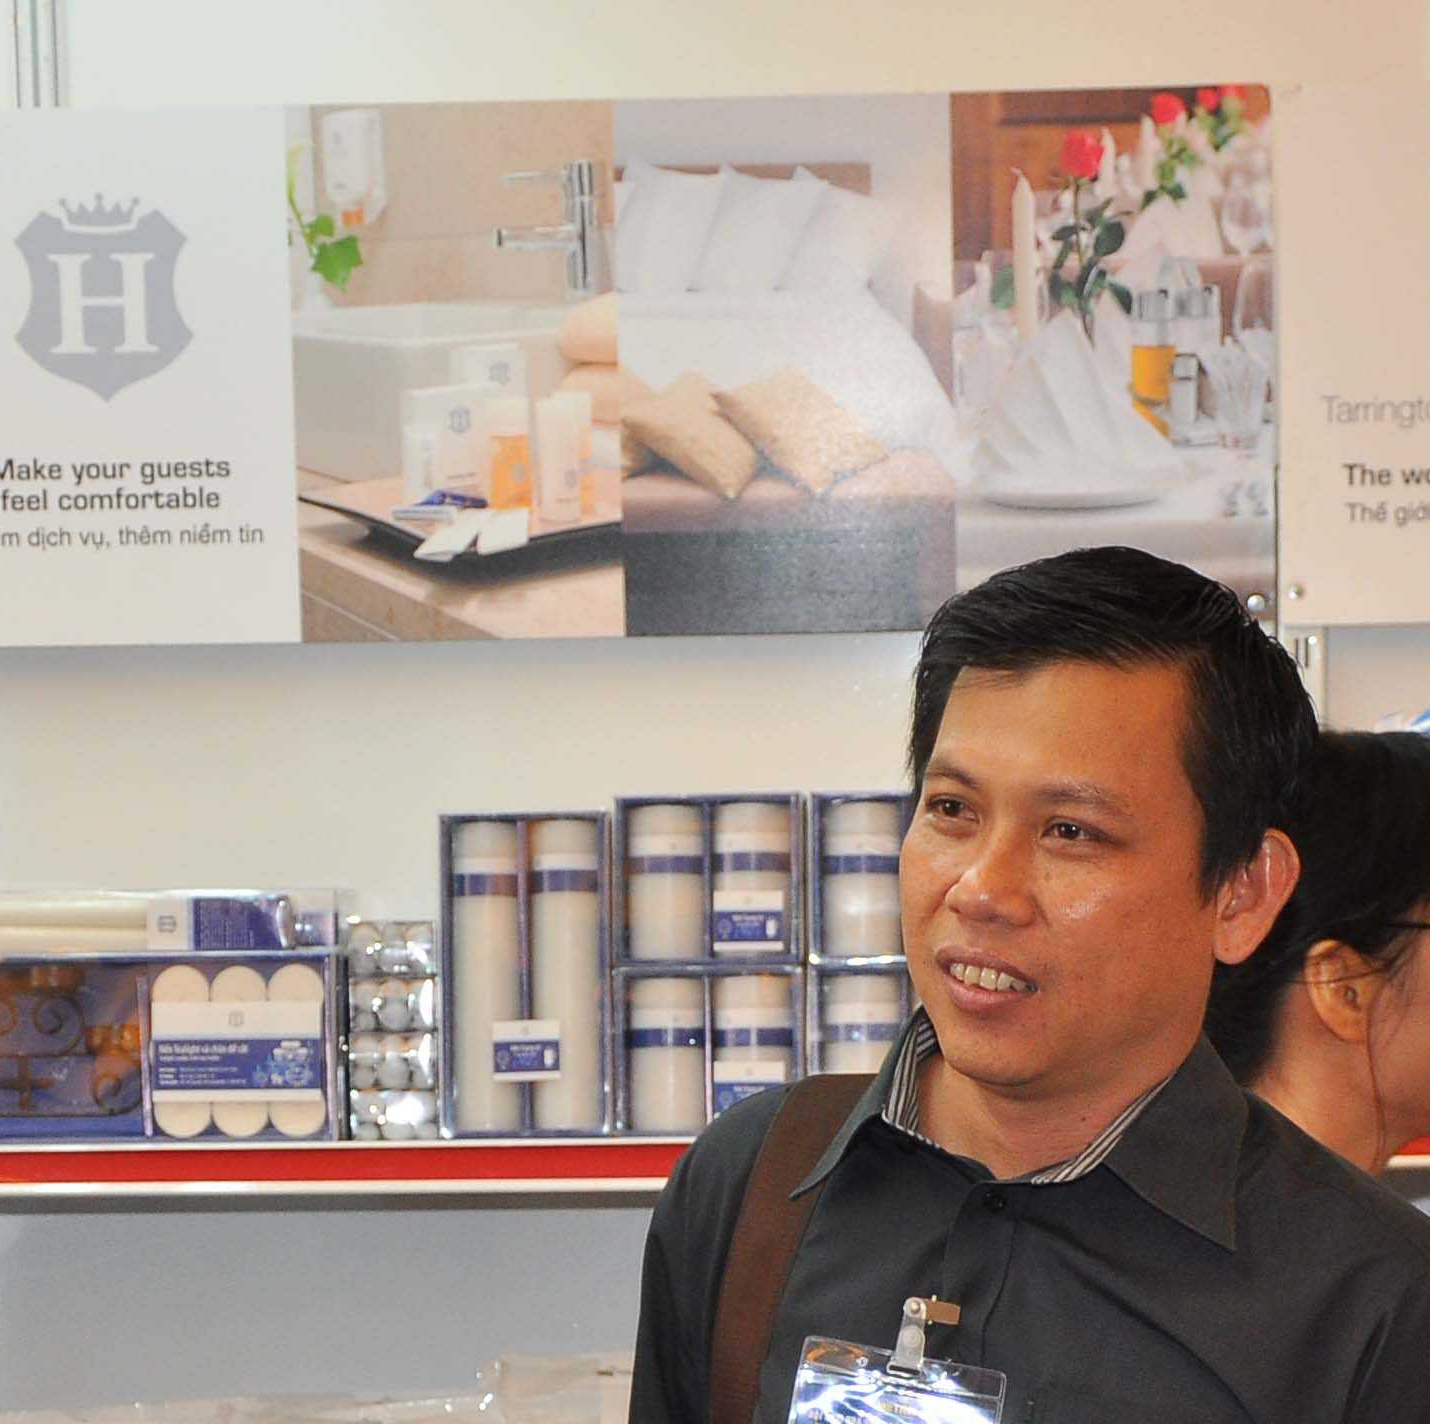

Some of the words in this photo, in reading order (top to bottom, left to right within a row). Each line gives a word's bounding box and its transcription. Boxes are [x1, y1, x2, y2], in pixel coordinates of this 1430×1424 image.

[72, 461, 131, 486] your
[140, 458, 231, 485] guests
[1343, 462, 1392, 486] The
[1, 489, 48, 512] feel
[57, 486, 220, 511] comfortable
[27, 524, 72, 551] dịch
[79, 530, 112, 551] vụ,
[118, 525, 172, 546] thêm
[238, 523, 264, 545] tin
